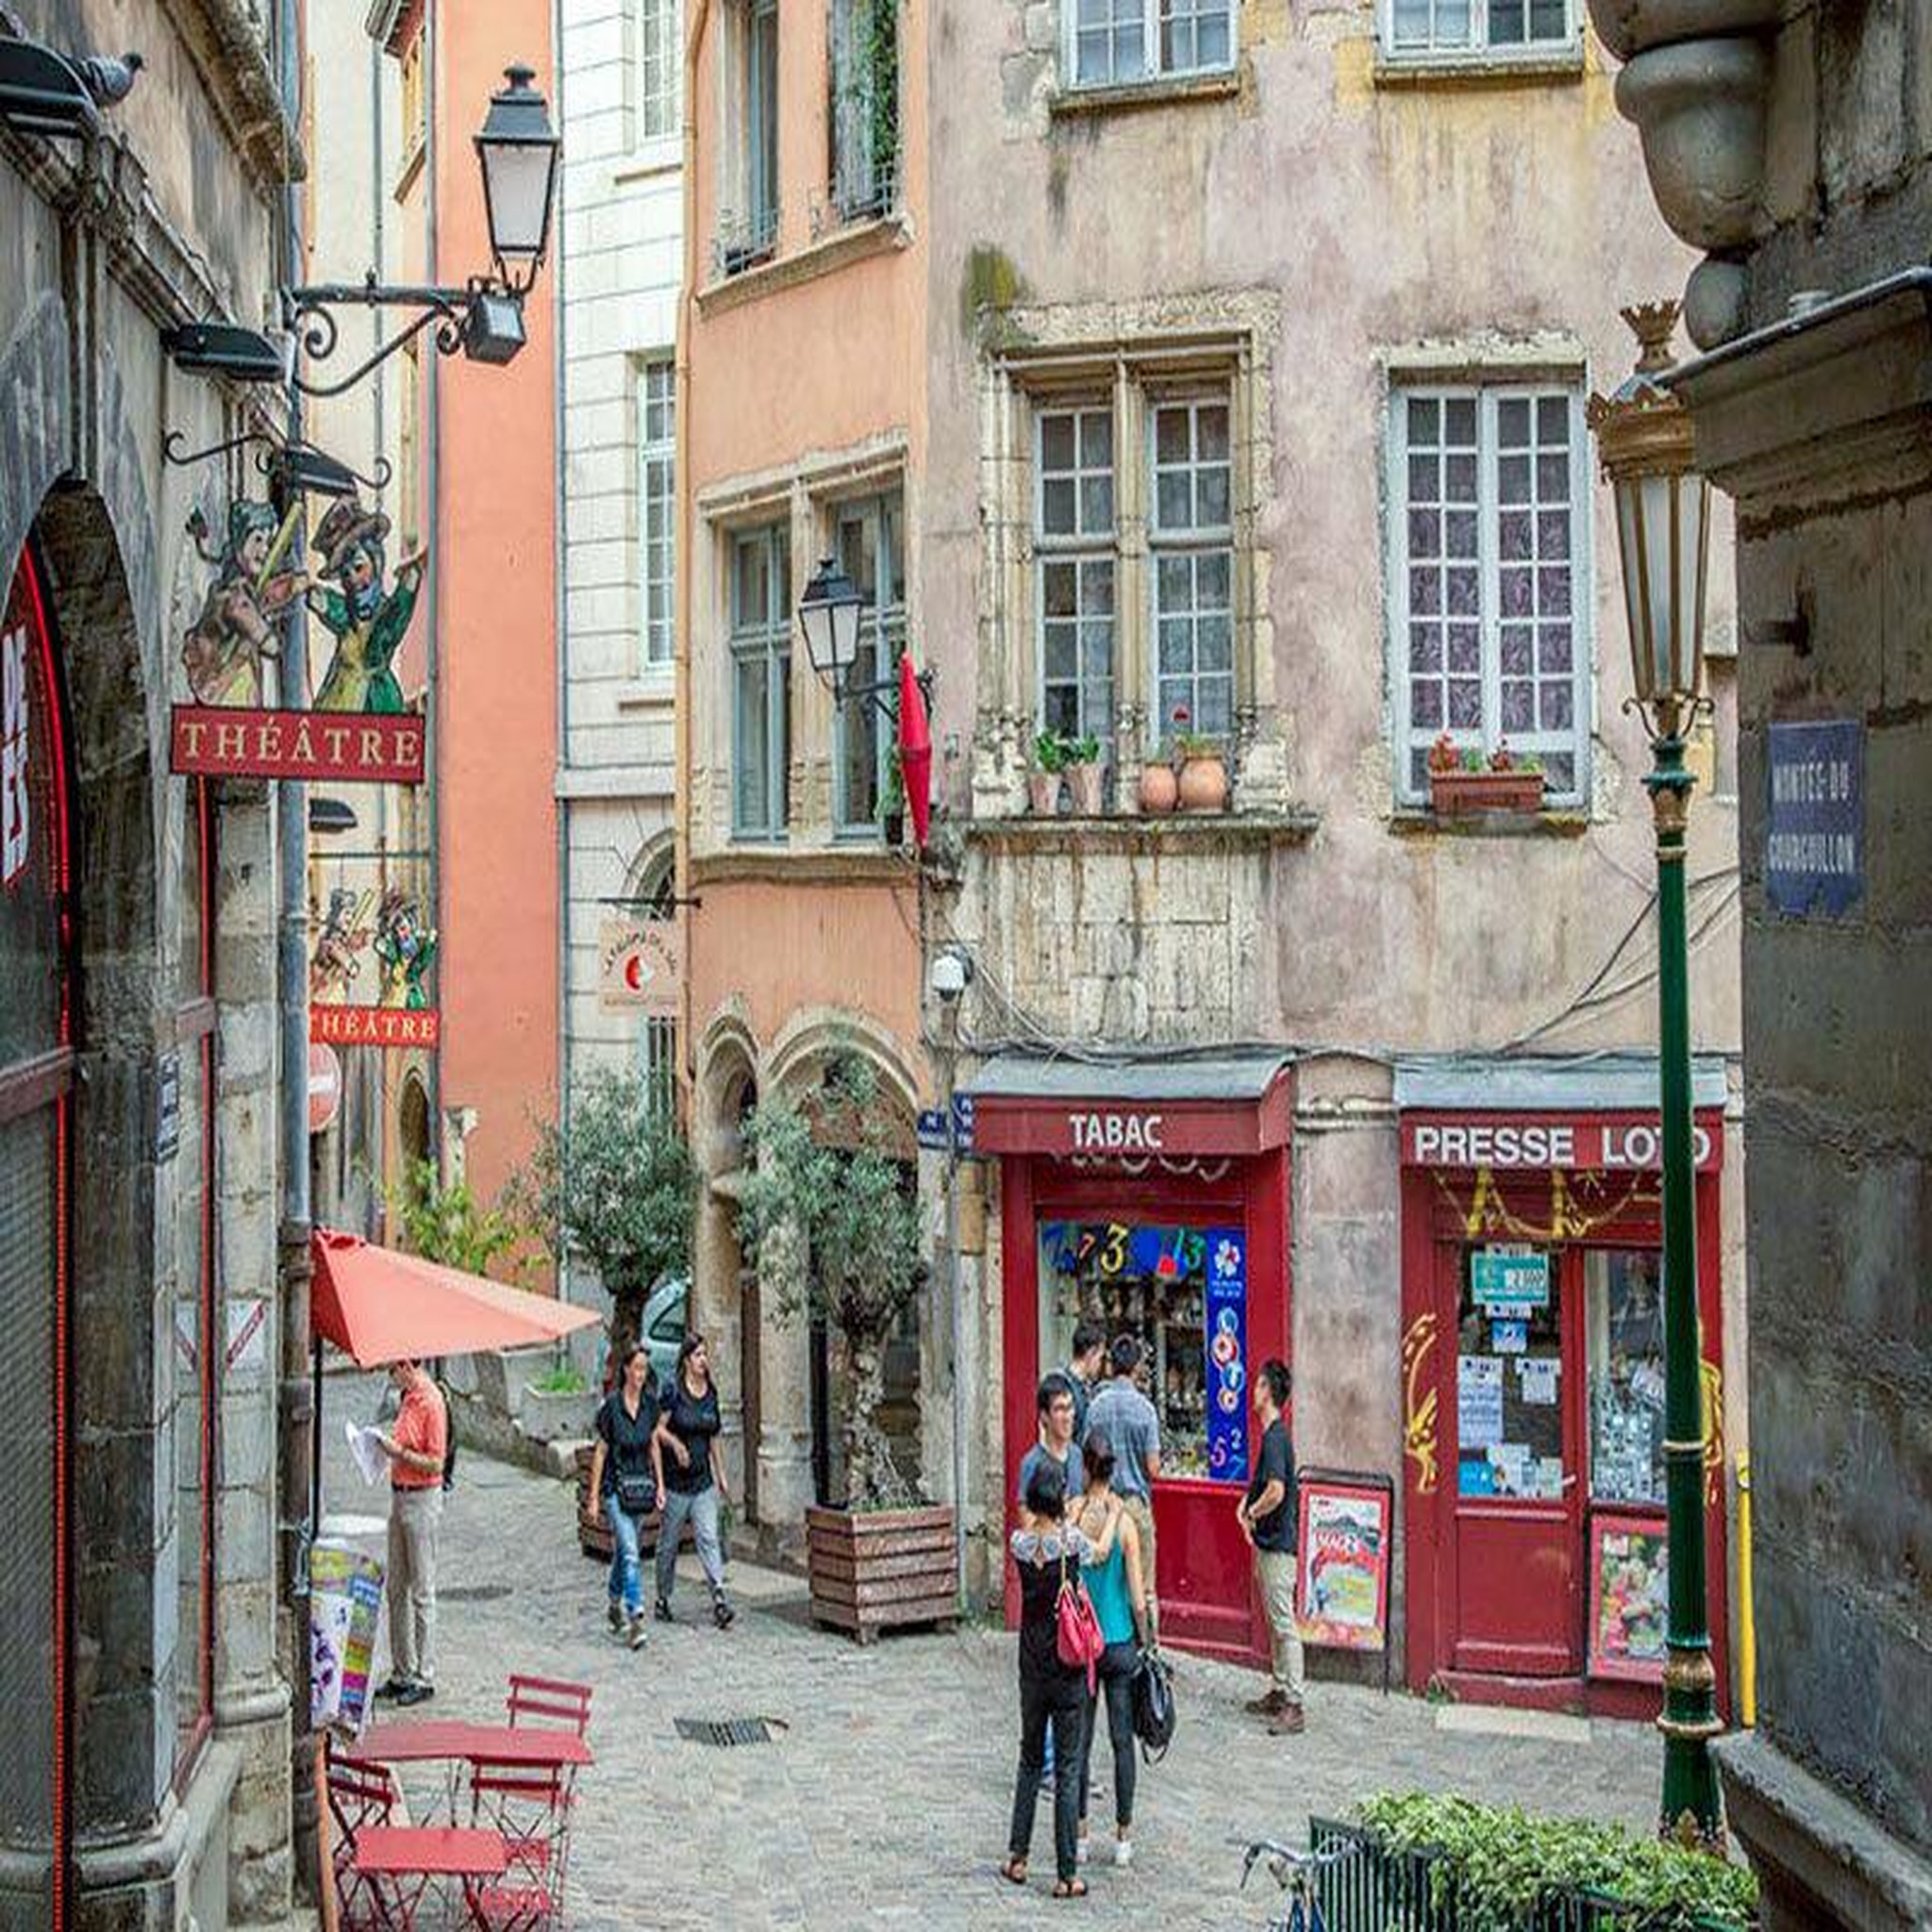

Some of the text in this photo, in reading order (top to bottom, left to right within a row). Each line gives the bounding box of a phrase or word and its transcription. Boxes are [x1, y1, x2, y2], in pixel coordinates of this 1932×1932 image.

[180, 715, 420, 767] THÉÂTRE
[1069, 1114, 1162, 1148] TABAC
[1415, 1126, 1710, 1165] PRESSE LOO
[1100, 1223, 1129, 1274] 3
[1209, 1436, 1227, 1468] 5
